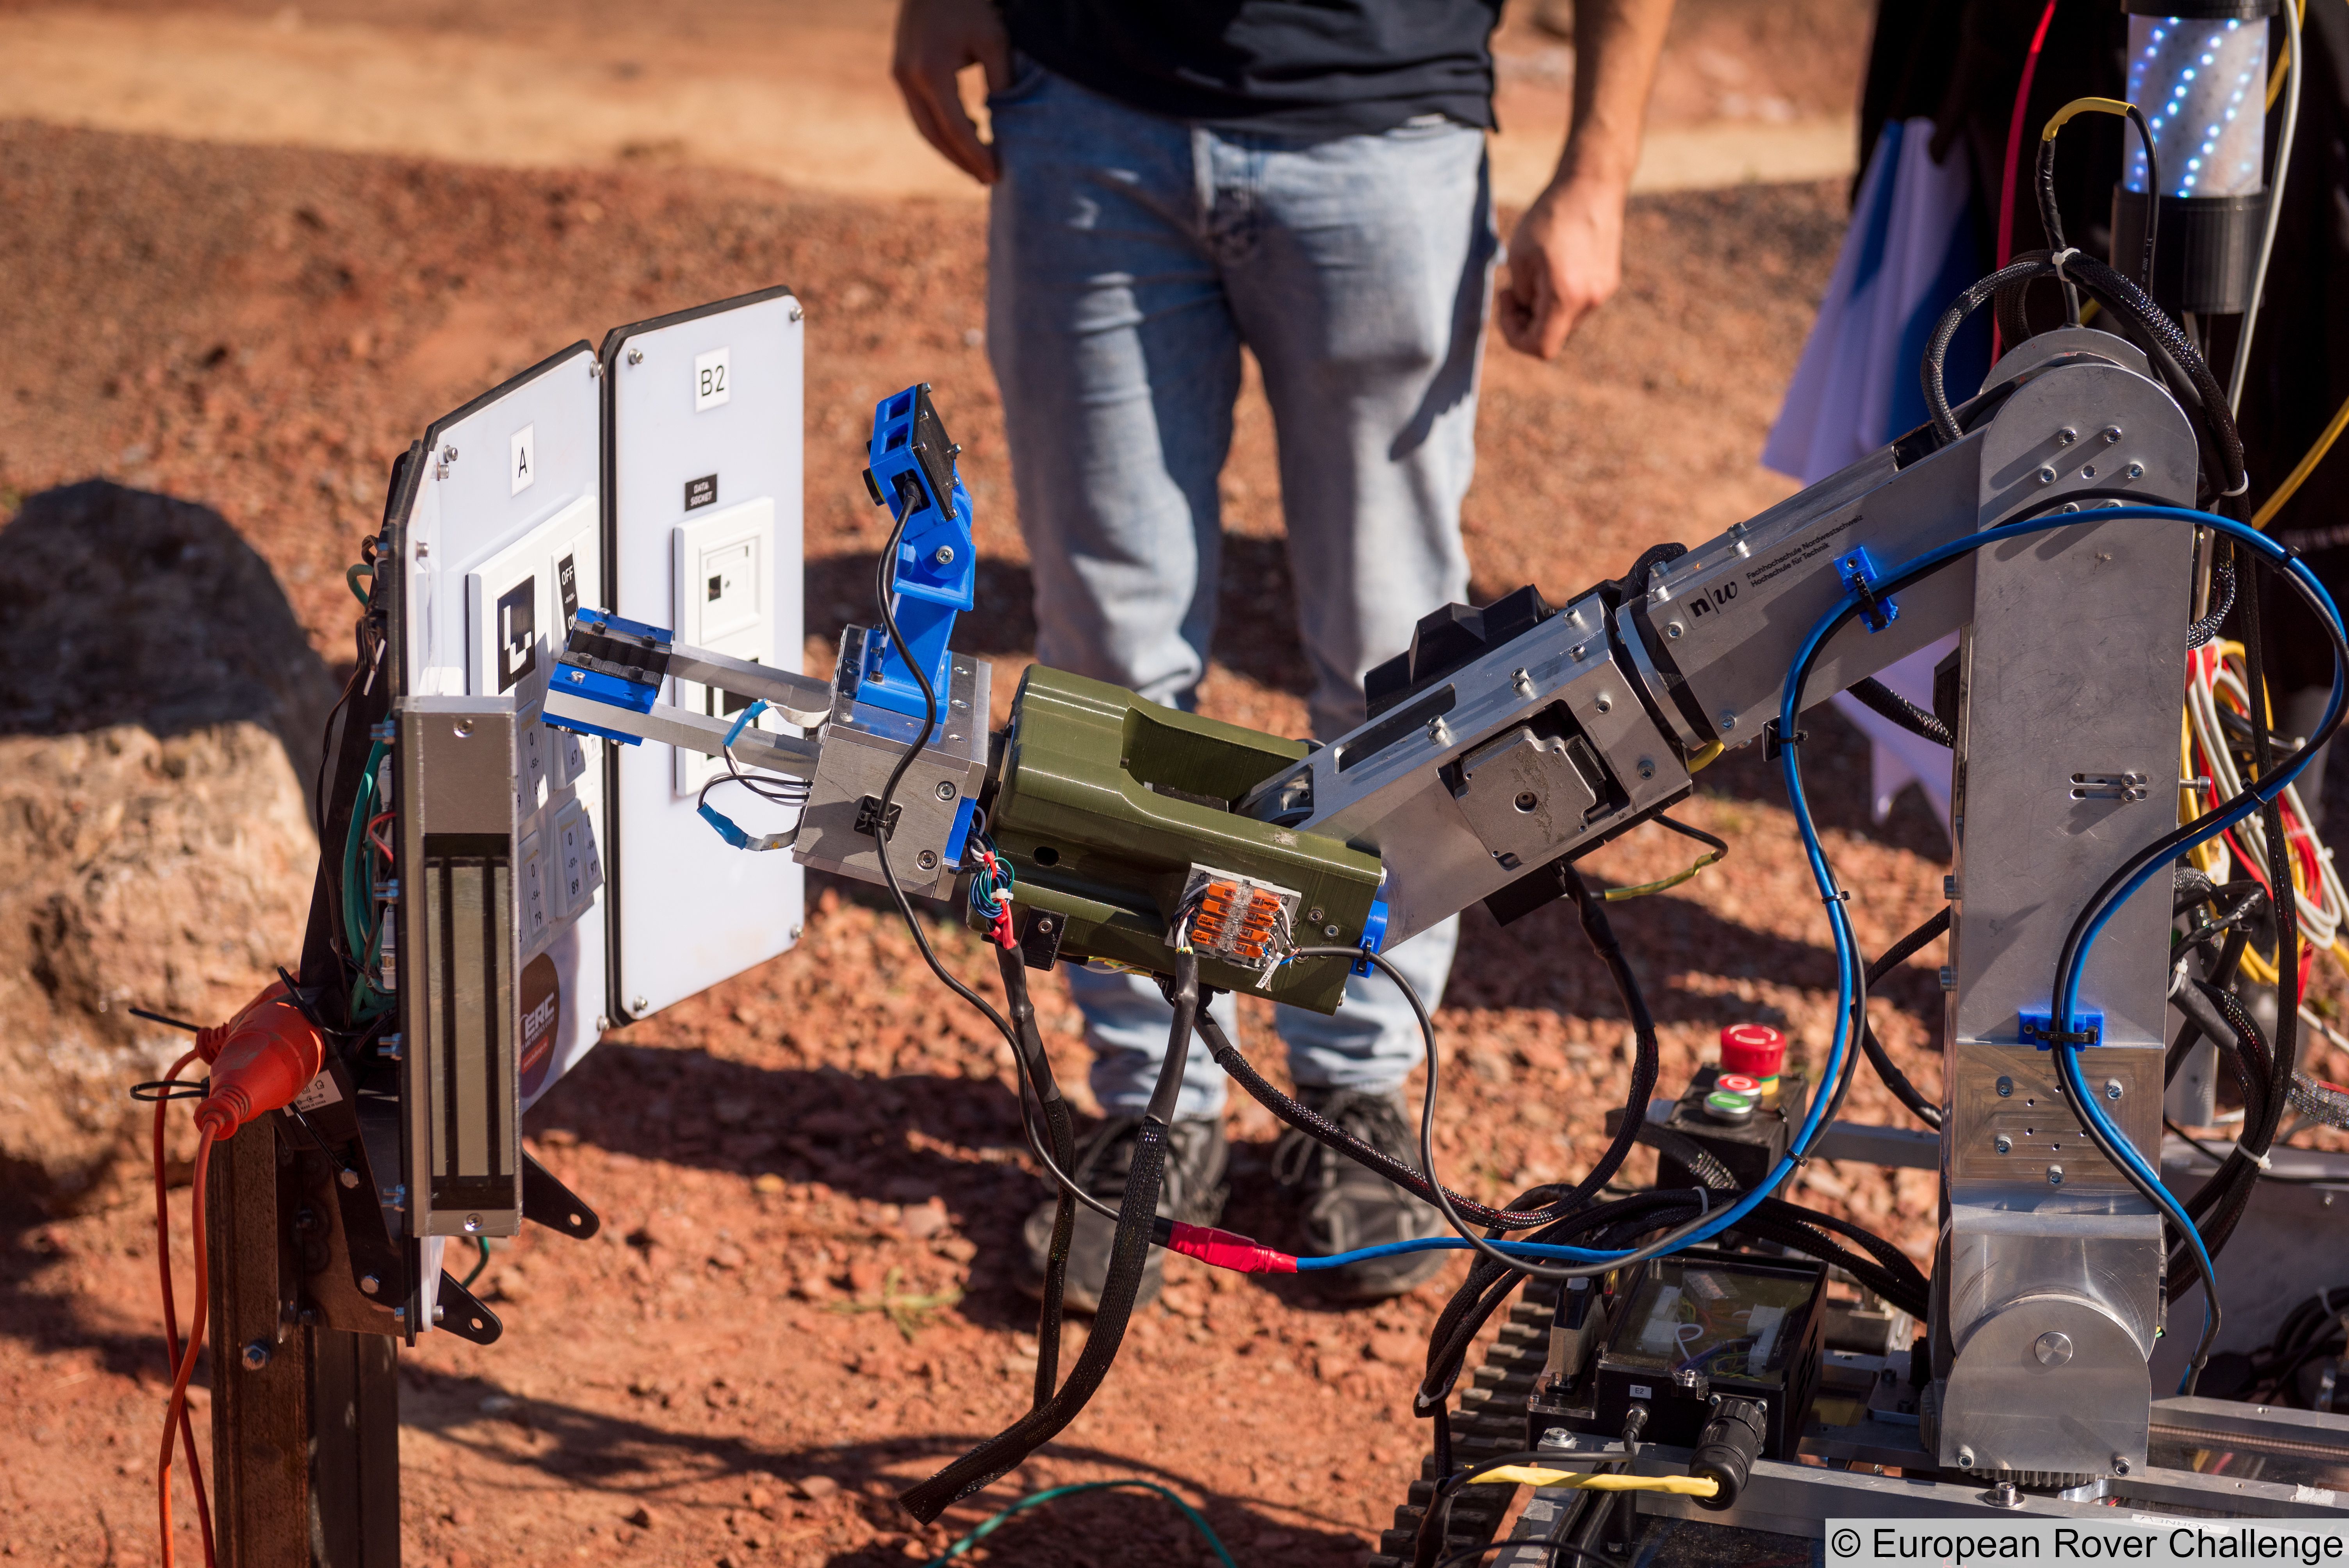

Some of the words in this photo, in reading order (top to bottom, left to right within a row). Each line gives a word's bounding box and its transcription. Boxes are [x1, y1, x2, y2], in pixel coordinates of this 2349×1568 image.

[700, 365, 725, 397] B2
[517, 446, 527, 478] A
[693, 481, 710, 494] DATA
[690, 491, 713, 506] SOCKET
[1746, 546, 1802, 579] Fachhochschule
[1802, 515, 1863, 550] Nordwestschweiz
[1750, 561, 1792, 587] Hochschule
[1791, 553, 1804, 567] für
[1802, 542, 1830, 559] Technik
[561, 565, 573, 586] OFF
[568, 610, 577, 631] ON
[591, 737, 596, 751] 71
[571, 749, 577, 766] 67
[534, 779, 540, 795] 61
[590, 861, 597, 876] 97
[571, 878, 579, 895] 89
[535, 911, 542, 927] 79
[525, 992, 554, 1039] ERC
